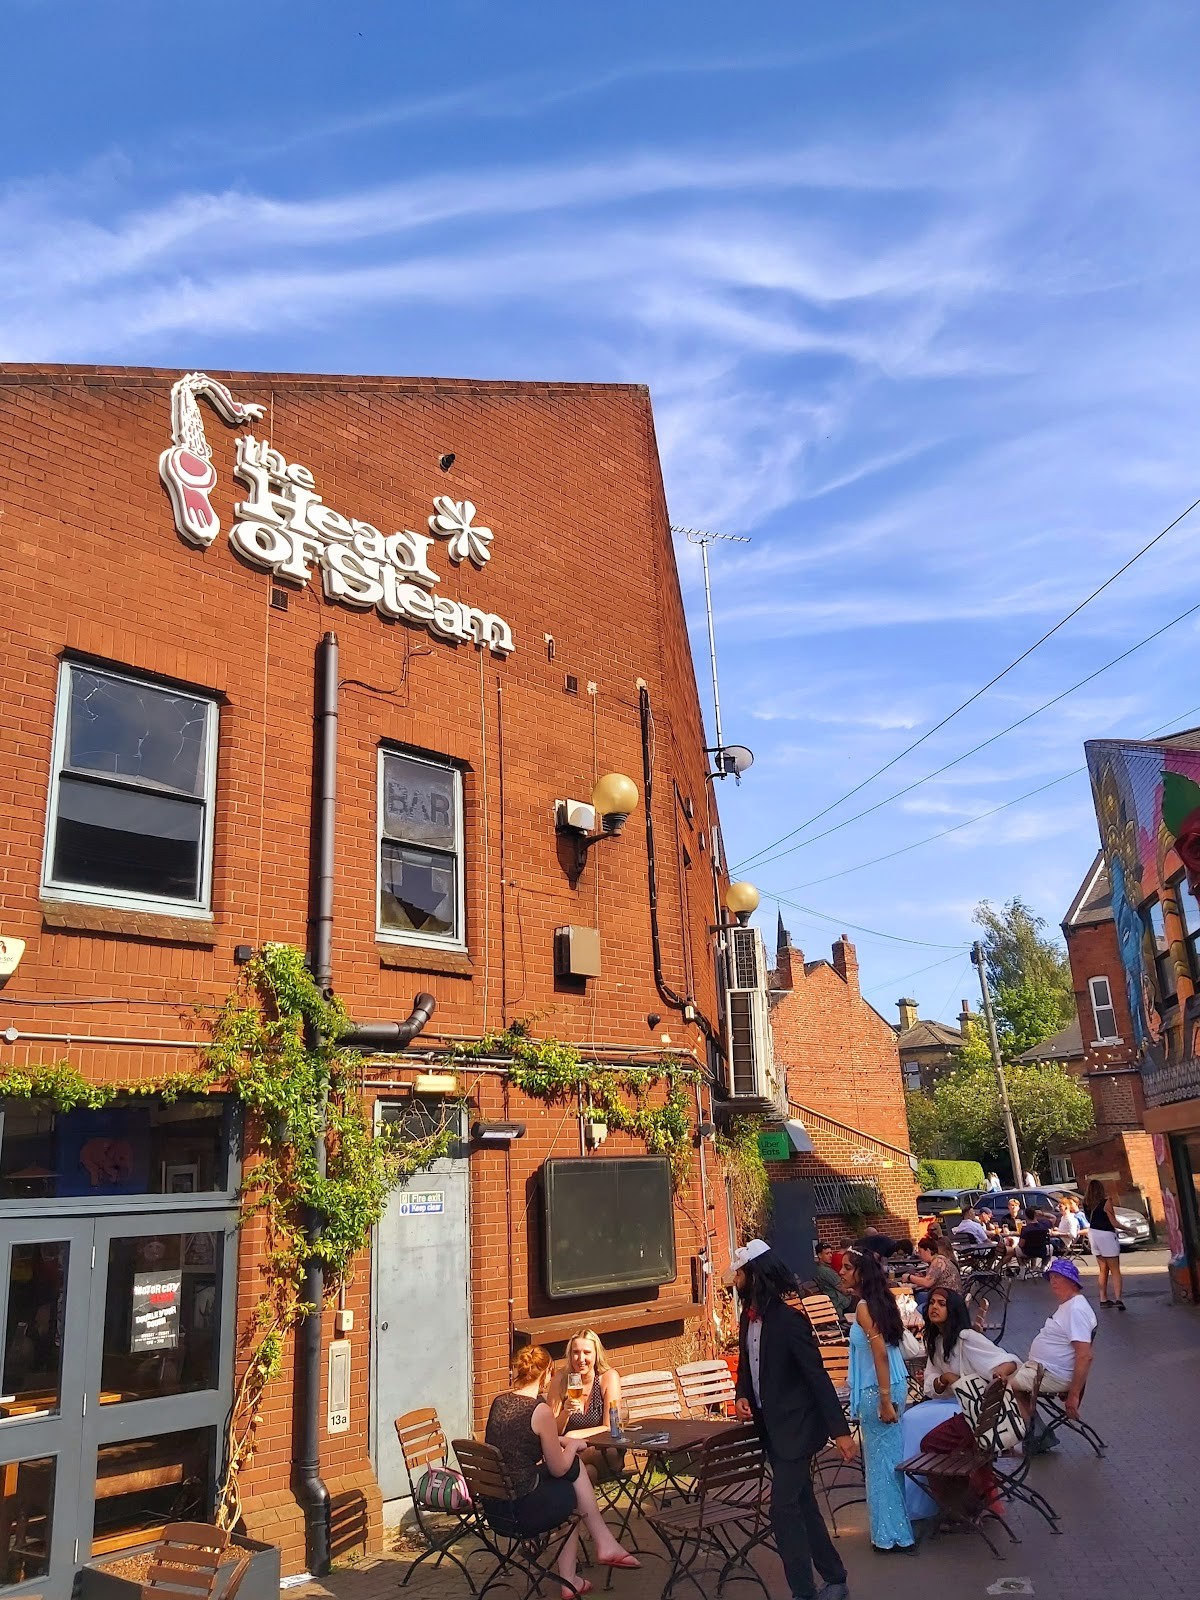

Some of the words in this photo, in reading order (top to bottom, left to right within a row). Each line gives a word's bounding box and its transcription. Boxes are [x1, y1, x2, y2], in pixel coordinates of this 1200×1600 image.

[235, 435, 315, 488] the
[234, 462, 441, 588] Head
[321, 542, 515, 656] Steam
[388, 782, 451, 827] BAR
[411, 1203, 427, 1213] Keep
[427, 1202, 442, 1211] clear
[412, 1194, 427, 1203] Fire
[427, 1193, 442, 1202] exit
[330, 1414, 347, 1426] 13a
